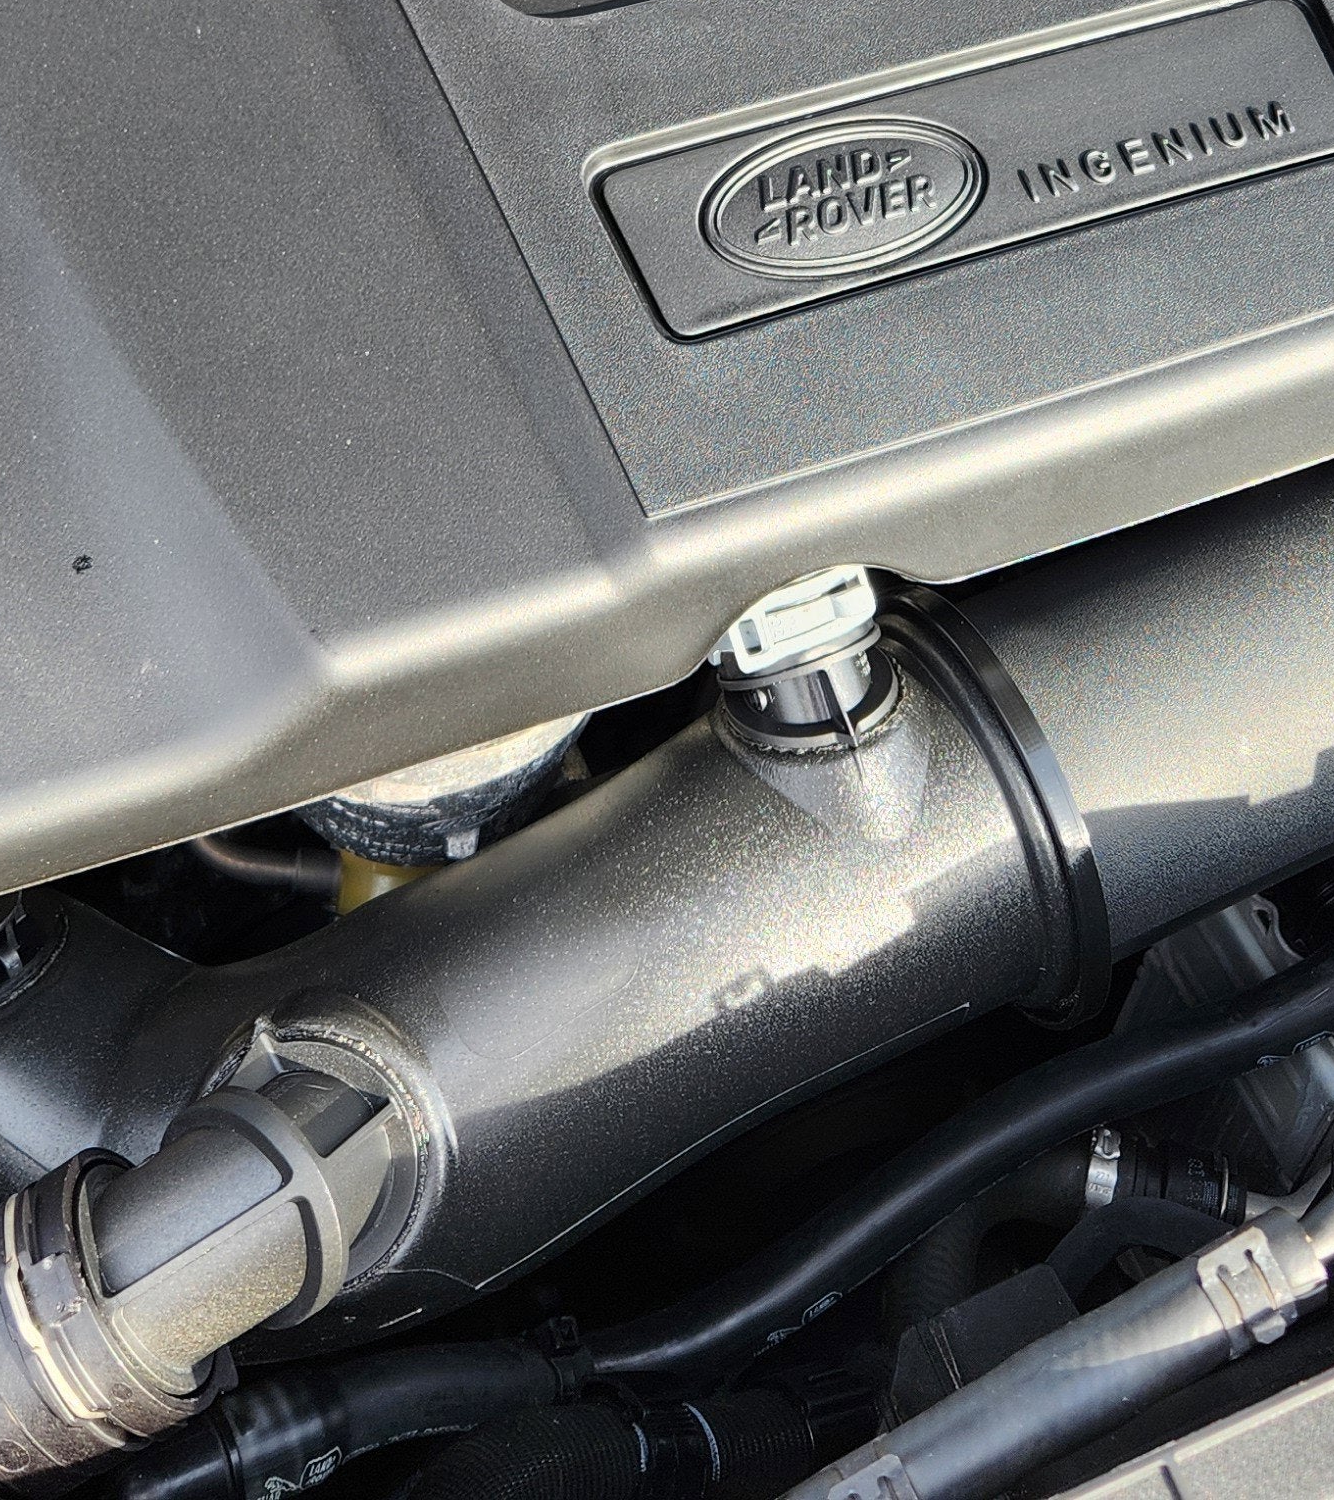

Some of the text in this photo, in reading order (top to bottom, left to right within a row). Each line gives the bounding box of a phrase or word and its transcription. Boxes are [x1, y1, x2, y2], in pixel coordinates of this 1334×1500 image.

[757, 150, 887, 211] LAND
[1018, 100, 1297, 204] INGENIUM
[784, 176, 939, 247] ROVER
